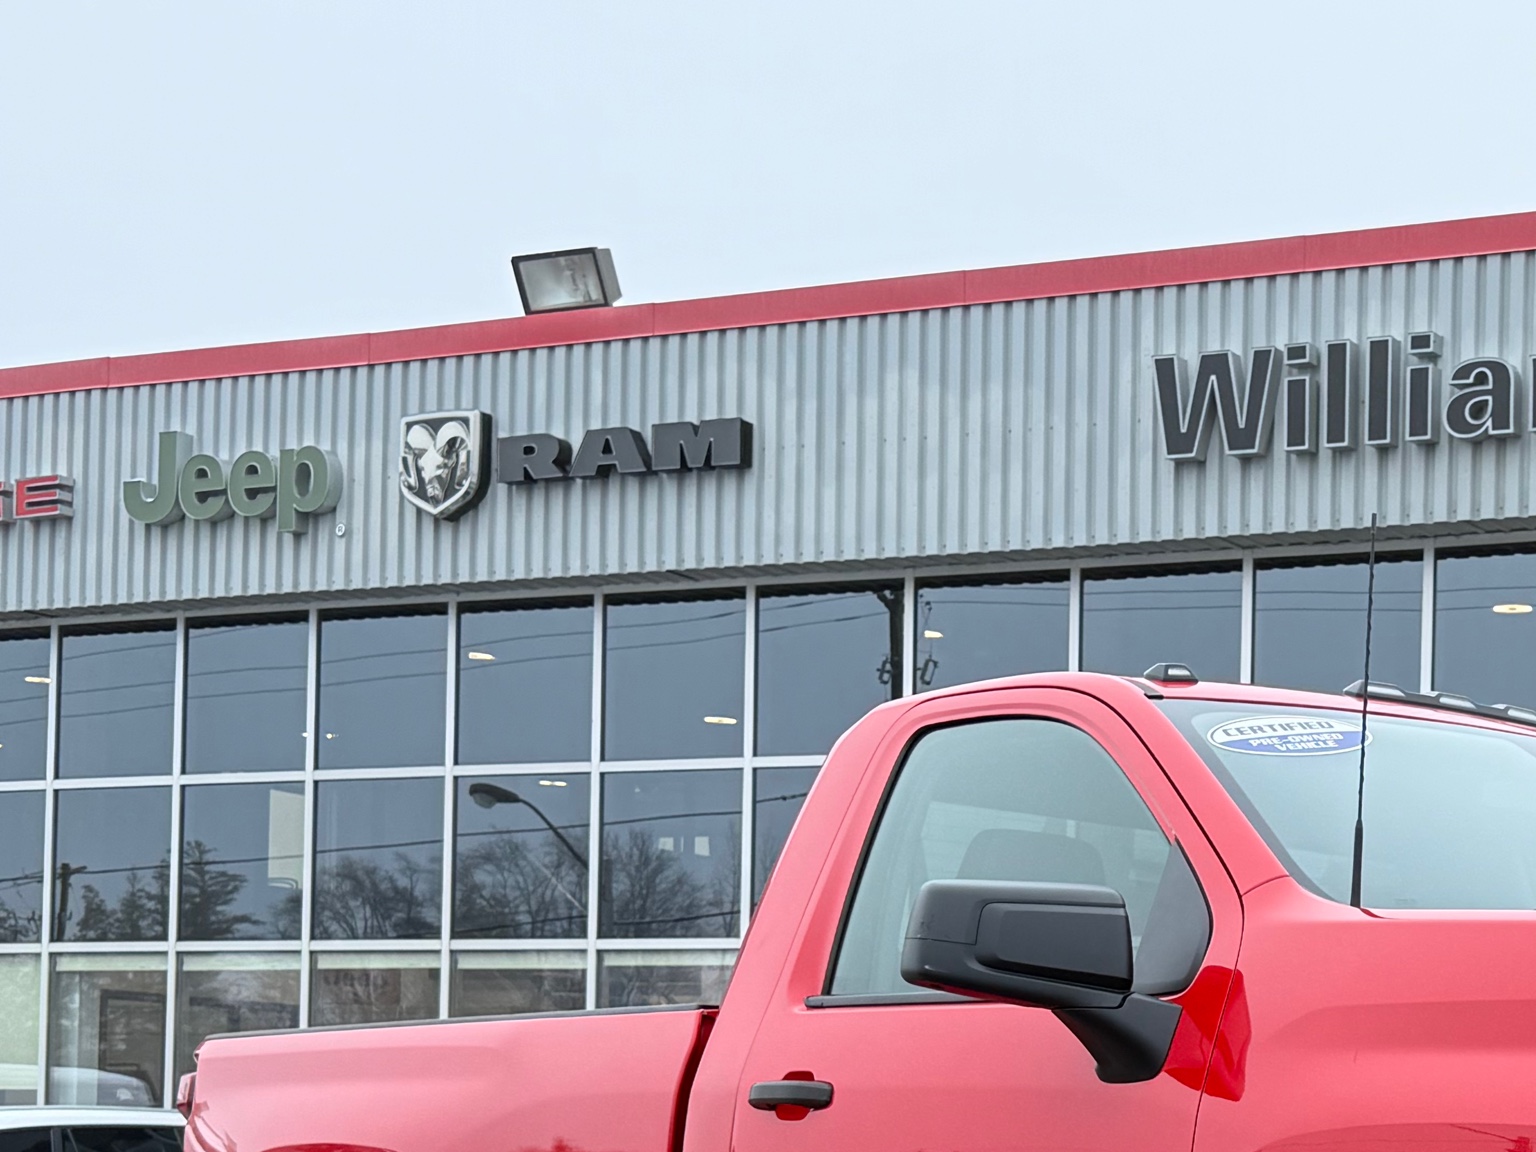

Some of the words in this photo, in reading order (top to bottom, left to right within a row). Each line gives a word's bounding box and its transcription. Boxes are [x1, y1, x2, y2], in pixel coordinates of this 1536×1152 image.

[497, 416, 754, 485] RAM
[122, 430, 344, 534] Jeep
[1221, 720, 1335, 738] CERTIFIED
[1248, 732, 1344, 748] PRE-OWNED
[1274, 739, 1340, 752] VEHICLE
